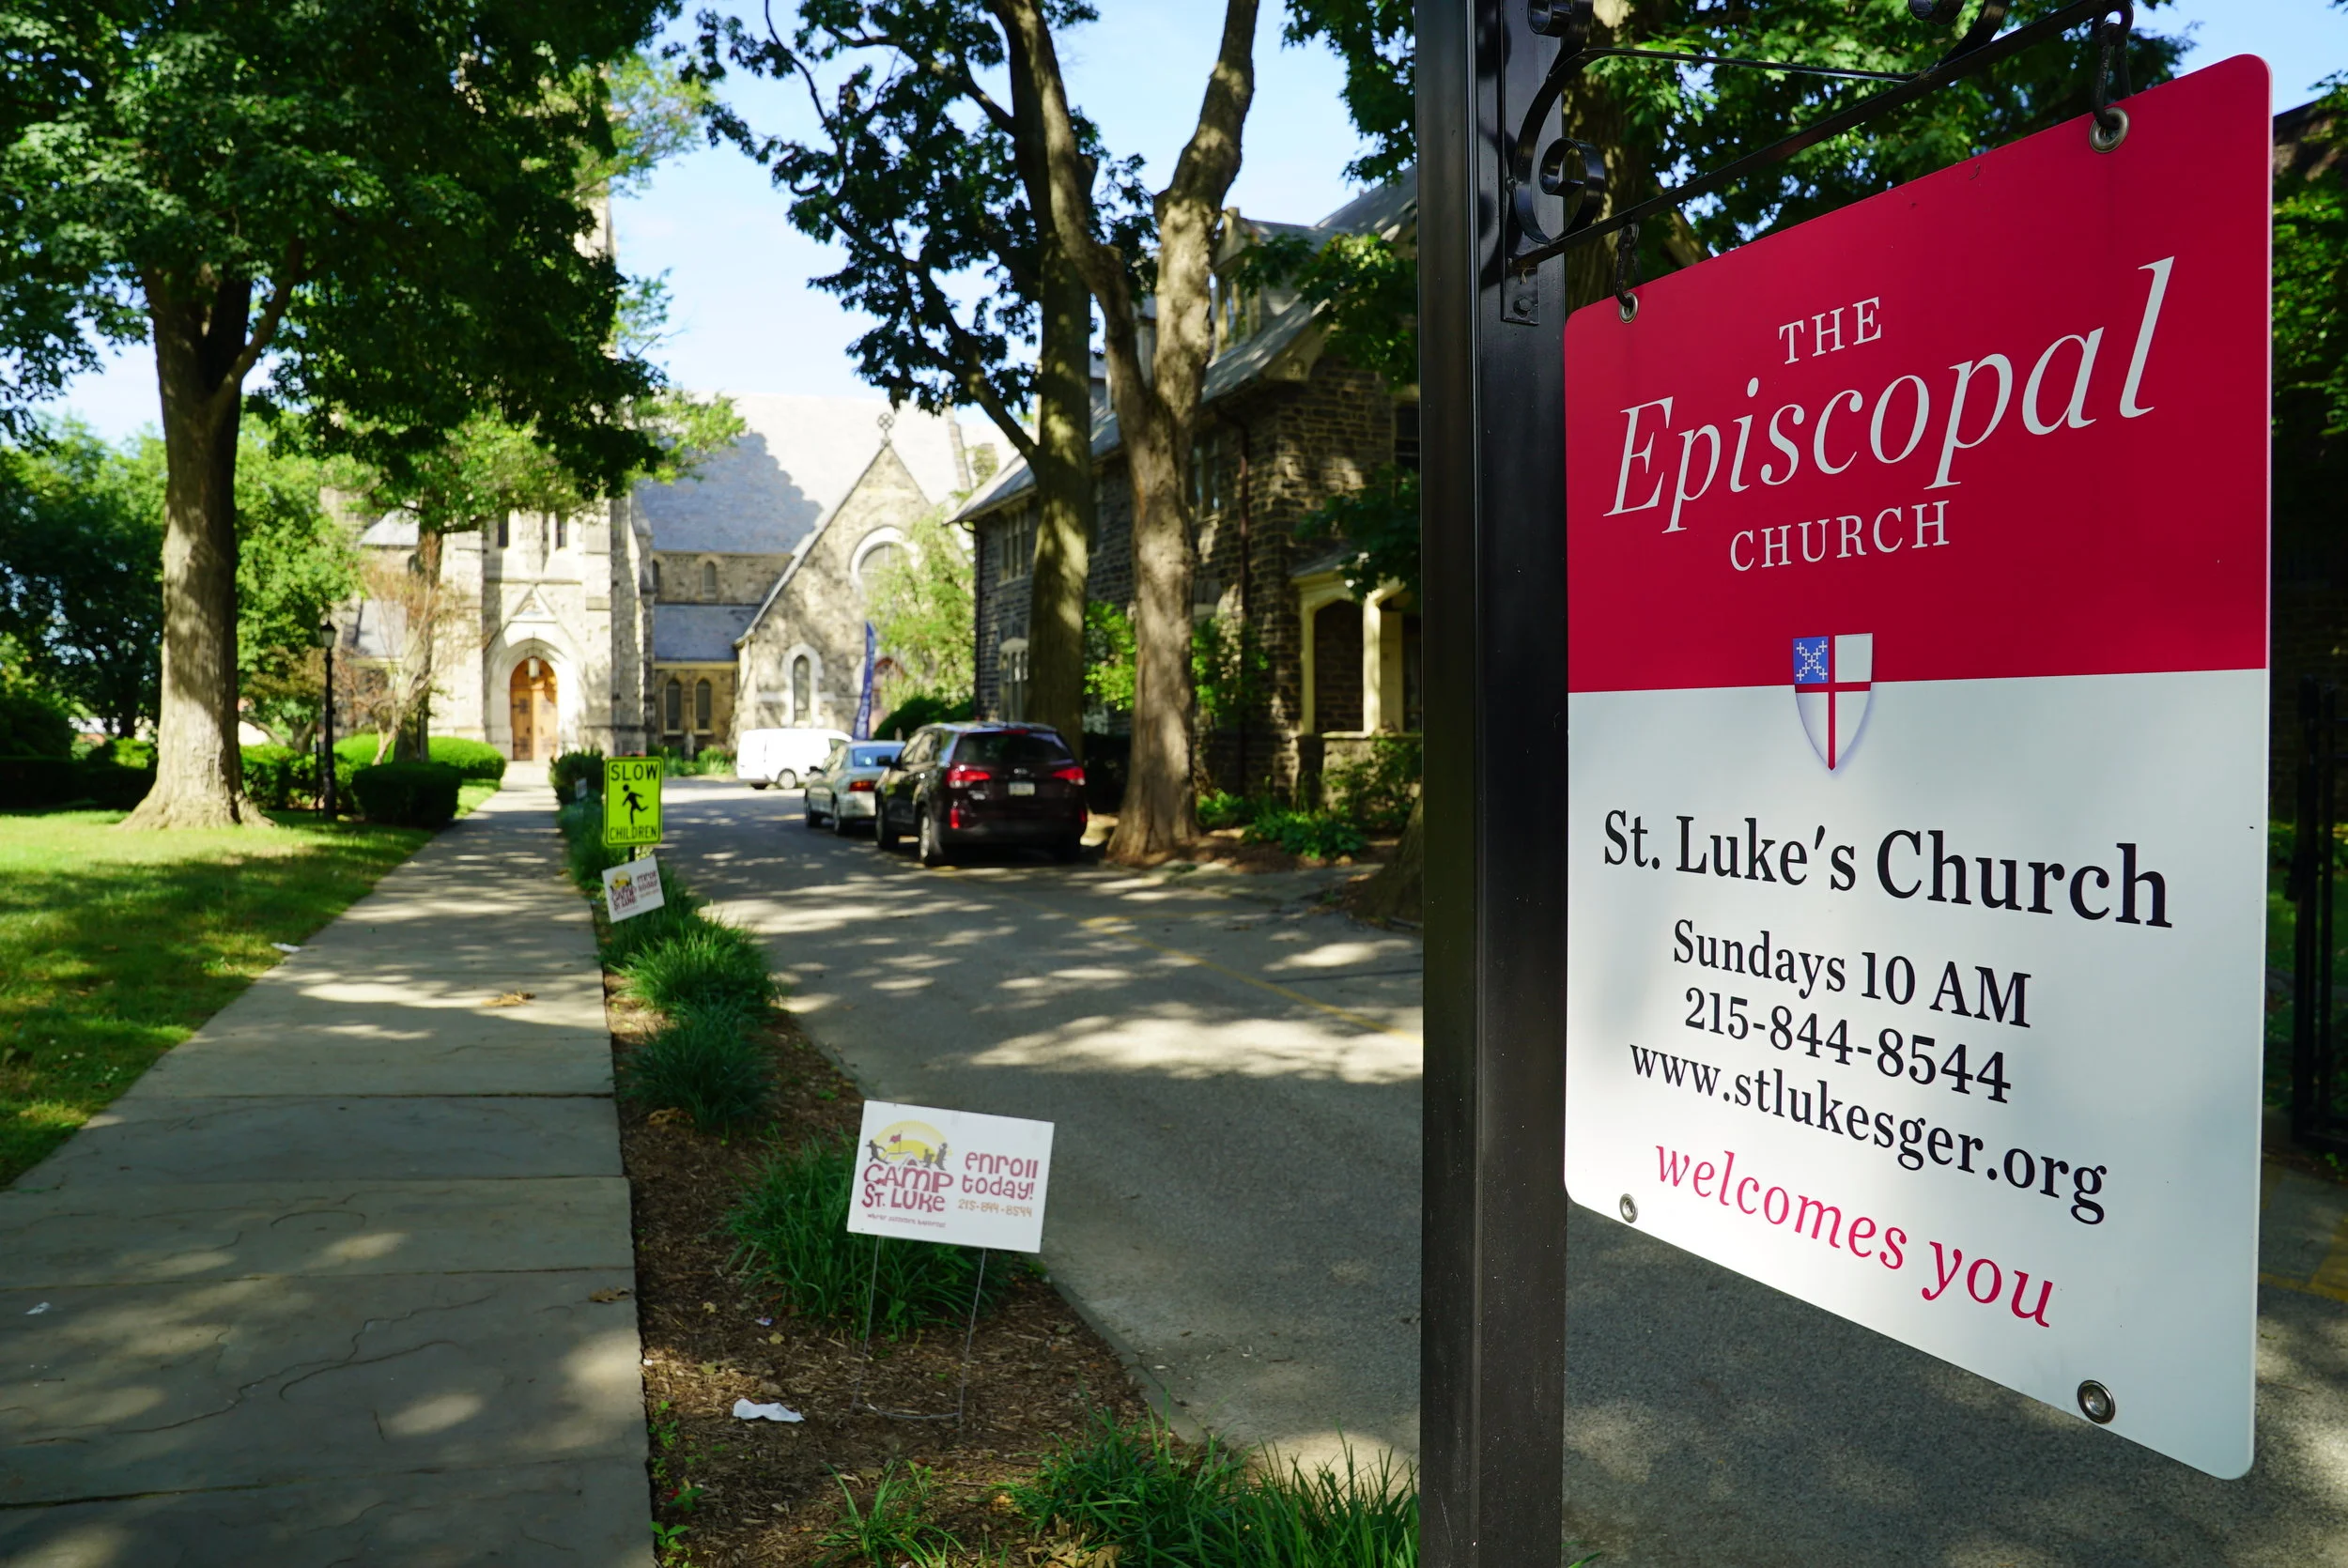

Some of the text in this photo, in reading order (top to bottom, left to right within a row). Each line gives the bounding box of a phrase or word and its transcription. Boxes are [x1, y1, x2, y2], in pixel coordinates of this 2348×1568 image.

[1778, 296, 1883, 365] THE
[1602, 254, 2175, 534] Episcopal
[1729, 500, 1951, 572] CHURCH
[610, 763, 657, 781] SLOW
[610, 825, 657, 840] CHILDREN
[1603, 809, 2173, 929] St. Luke's Church
[1673, 918, 2032, 1029] Sundays 10 AM
[1684, 987, 2012, 1105] 215-844-8544
[863, 1152, 1039, 1193] CAMP enroll
[1630, 1044, 2109, 1225] www.stlukesger.org
[962, 1174, 1035, 1200] today!
[1656, 1145, 2055, 1329] welcomes you
